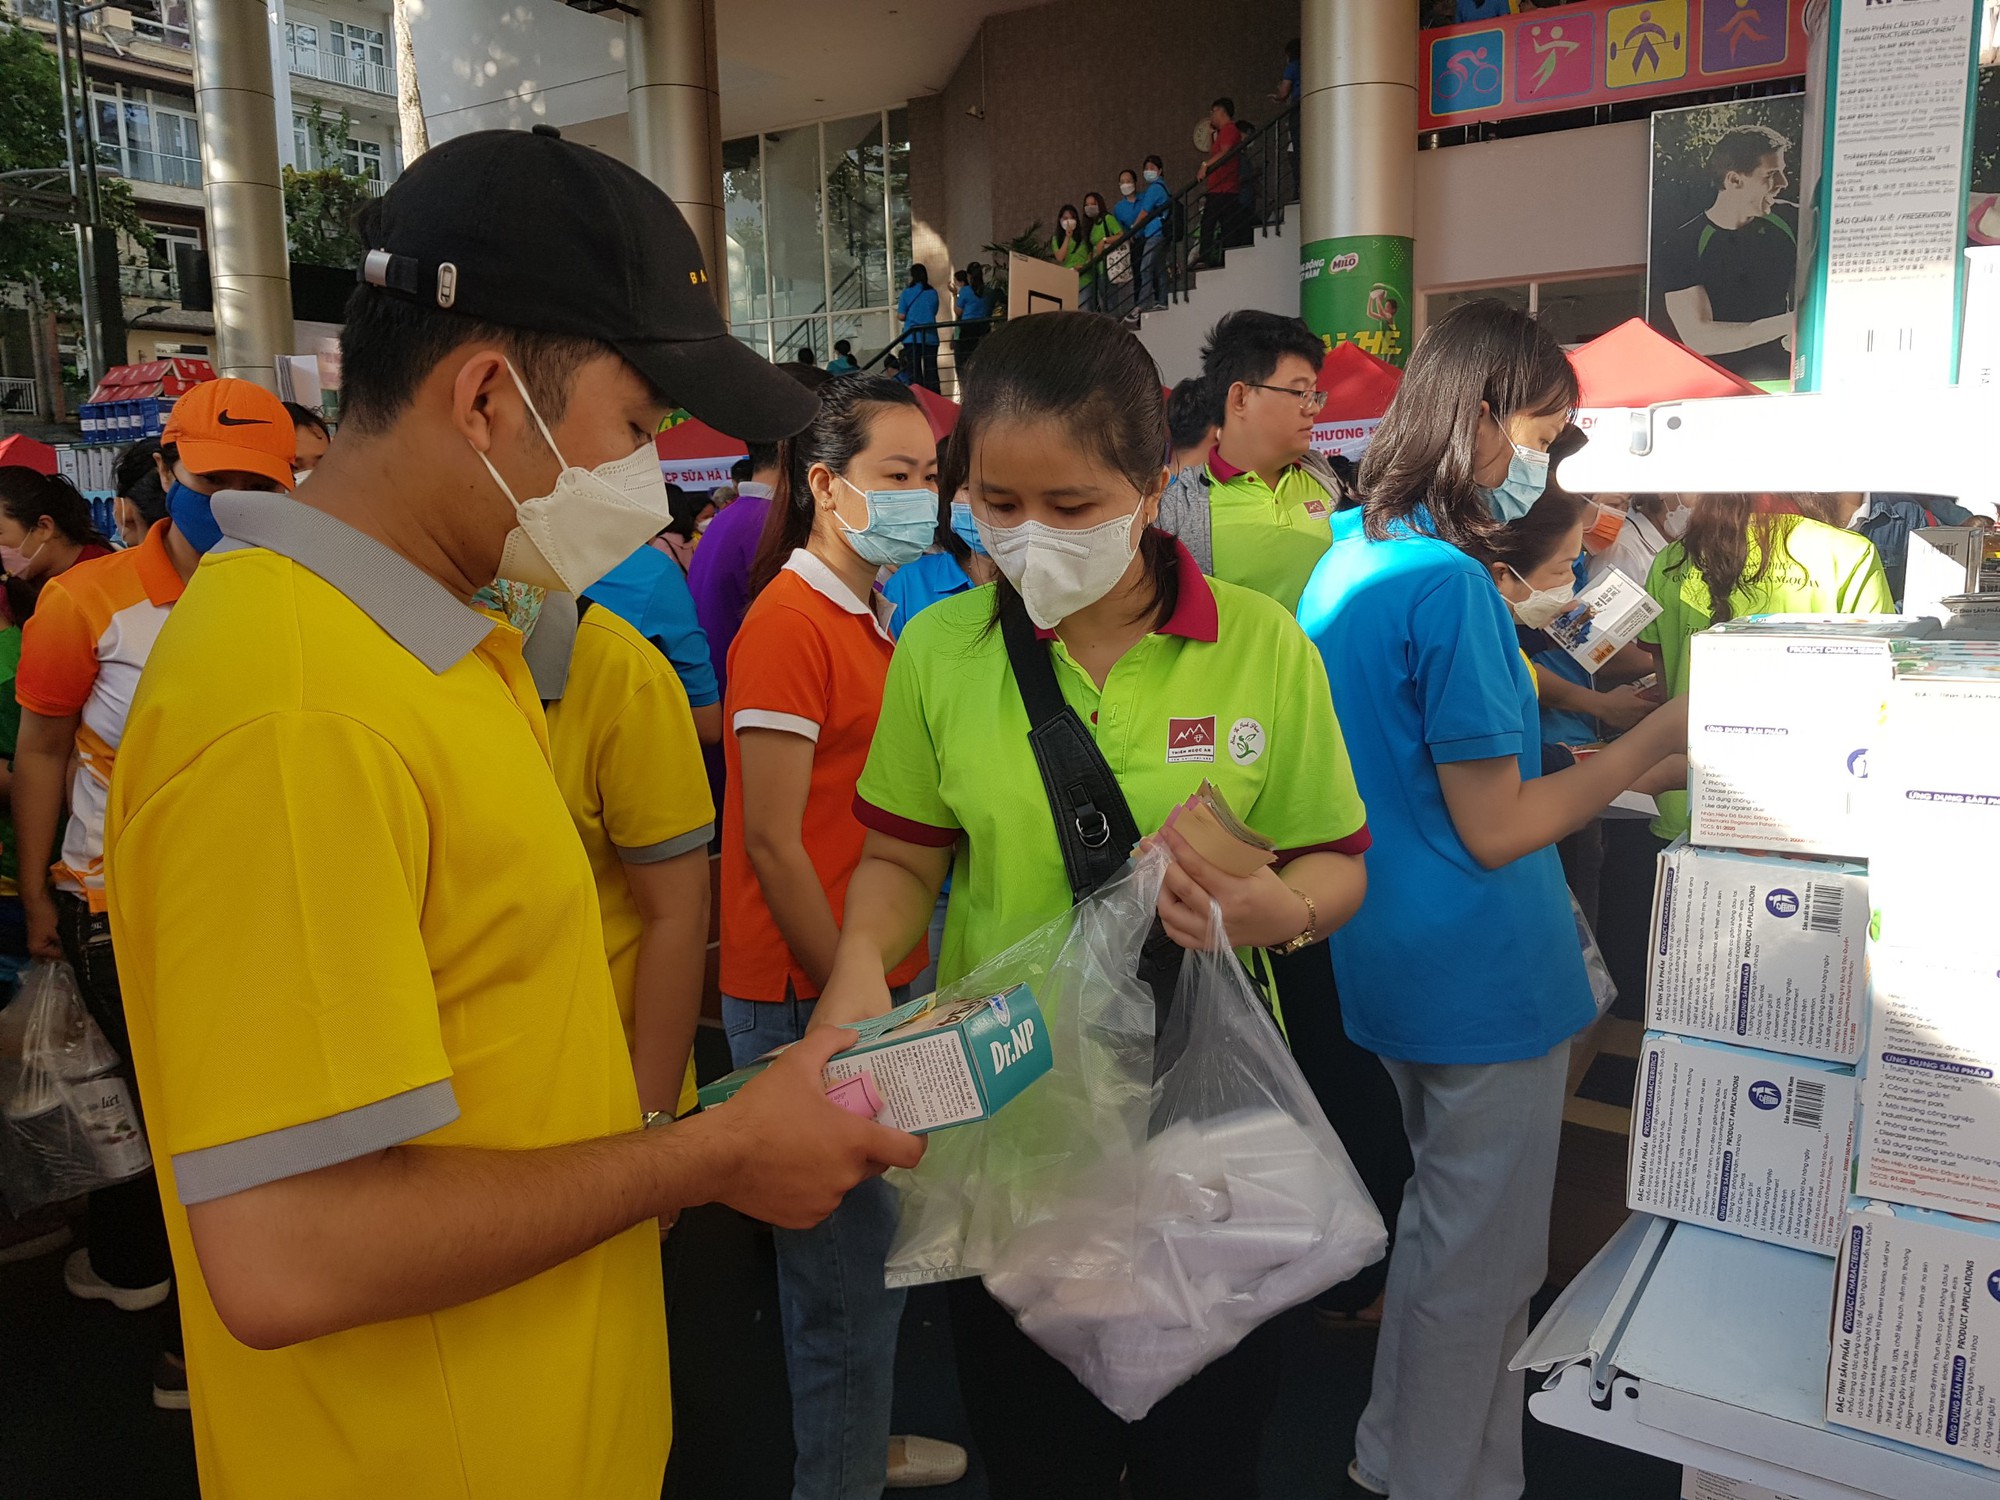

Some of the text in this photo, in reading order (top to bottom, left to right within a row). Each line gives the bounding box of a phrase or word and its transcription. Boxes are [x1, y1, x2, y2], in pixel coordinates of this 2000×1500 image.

[1333, 258, 1356, 270] MILO
[1791, 645, 1822, 654] PRODUCT
[1731, 805, 1752, 813] against
[1804, 893, 1812, 903] Việt
[1660, 869, 1673, 953] PRODUCT CHARACTERISTICS
[1744, 885, 1756, 958] PRODUCT APPLICATIONS
[1657, 960, 1665, 979] PHẨM
[1742, 965, 1750, 985] PHẨM
[1656, 978, 1664, 992] SẢN
[1655, 1007, 1663, 1021] ĐẶC
[1740, 999, 1748, 1018] DỤNG
[1738, 1019, 1746, 1034] ỨNG
[989, 1018, 1035, 1075] Dr.NP
[1885, 1054, 1991, 1077] ỨNG DỤNG SẢN PHẨM
[1787, 1076, 1795, 1087] Nam
[1643, 1054, 1657, 1135] PRODUCT CHARACTERISTICS
[1882, 1092, 1927, 1105] Amusement
[1726, 1075, 1740, 1146] PRODUCT APPLICATIONS
[1881, 1111, 1914, 1122] Industrial
[1879, 1129, 1907, 1140] Disease
[1723, 1153, 1732, 1172] PHẨM
[1877, 1147, 1890, 1155] Use
[1892, 1150, 1911, 1160] daily
[1912, 1154, 1939, 1164] against
[1636, 1141, 1649, 1202] ĐẶC TÍNH SẢN PHẨM
[1722, 1172, 1730, 1185] SẢN
[1844, 1229, 1862, 1330] PRODUCT CHARACTERISTICS
[1957, 1260, 1975, 1350] PRODUCT APPLICATIONS
[1904, 1409, 1914, 1429] Design
[1921, 1273, 1928, 1283] no
[1835, 1338, 1851, 1413] ĐẶC TÍNH SẢN PHẨM
[1865, 1403, 1874, 1418] Face
[1871, 1341, 1881, 1371] extremely
[1876, 1393, 1885, 1425] respiratory
[1948, 1357, 1965, 1442] ỨNG DỤNG SẢN PHẨM
